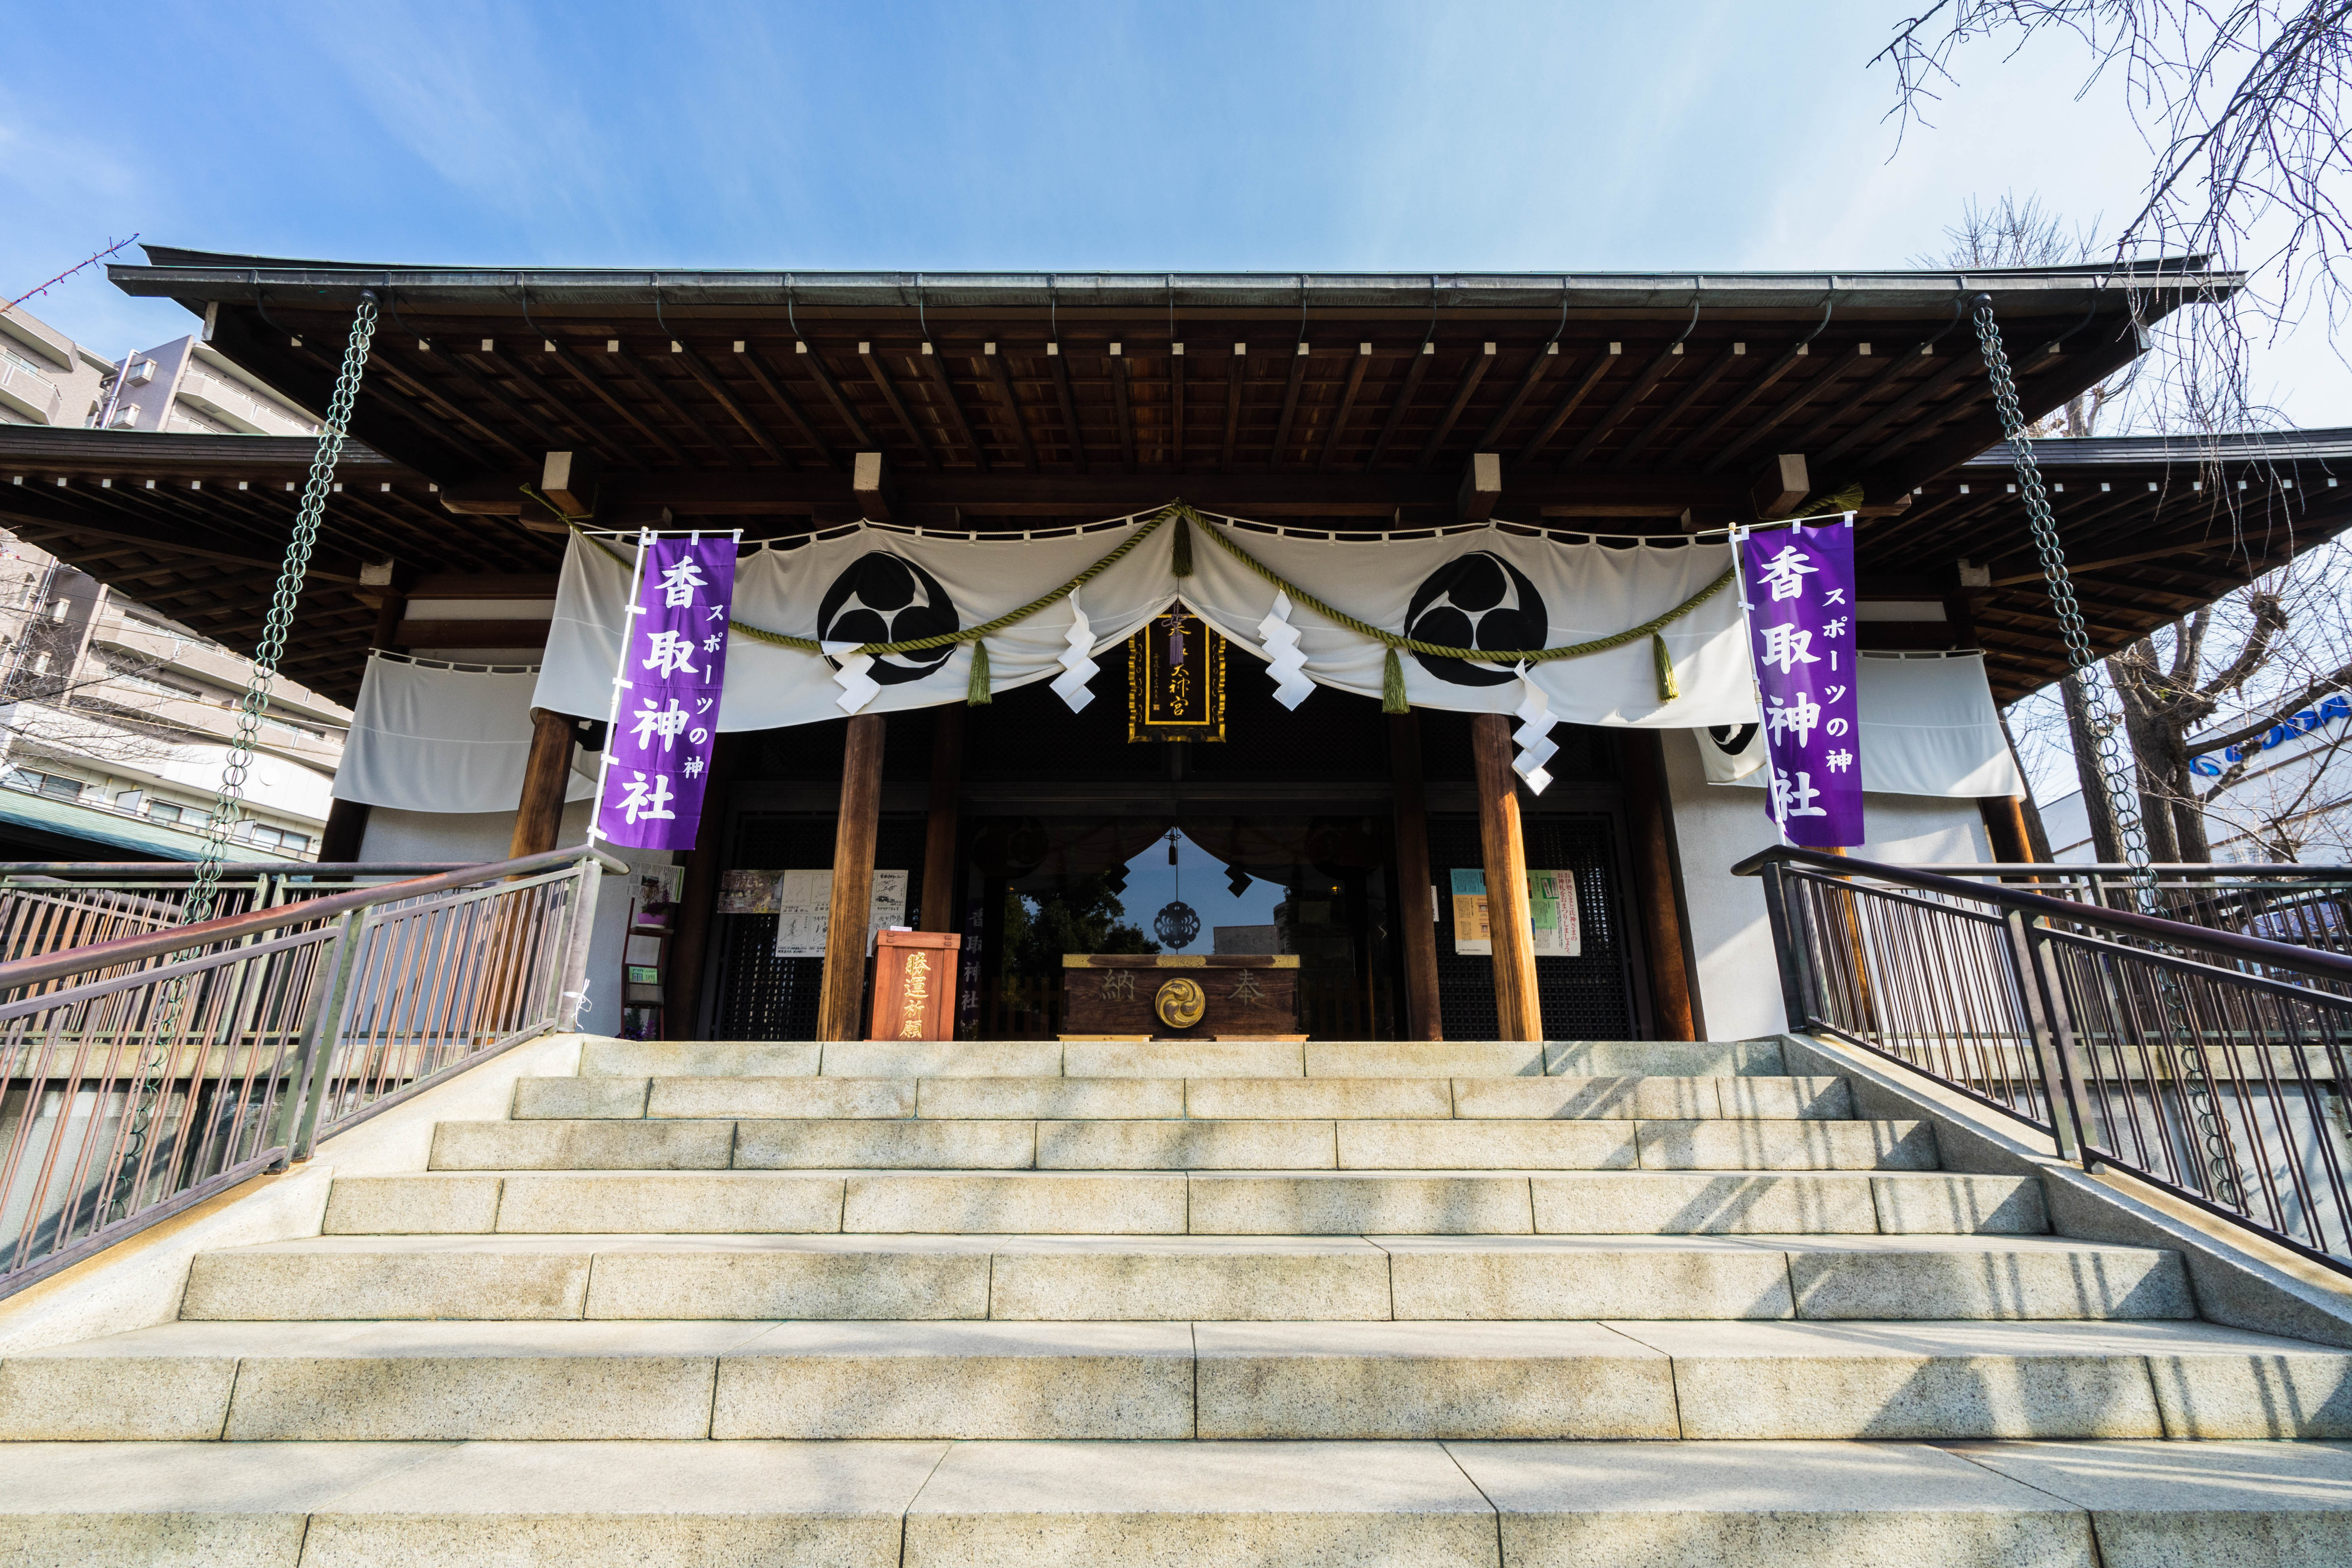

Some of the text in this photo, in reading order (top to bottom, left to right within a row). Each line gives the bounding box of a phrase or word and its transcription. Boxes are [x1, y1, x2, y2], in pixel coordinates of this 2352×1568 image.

[615, 555, 708, 825] 香取神社
[682, 604, 724, 779] スポーツの神
[1757, 546, 1827, 821] 香取神社
[1822, 588, 1853, 773] スポーツの神
[961, 907, 984, 1011] 香取神社
[1557, 873, 1571, 954] お神札をおまつりしましょう。
[1564, 873, 1577, 941] お伊勢さまと氏神さまの
[899, 951, 931, 1038] 勝運祈願
[1101, 968, 1266, 1006] 奉 納
